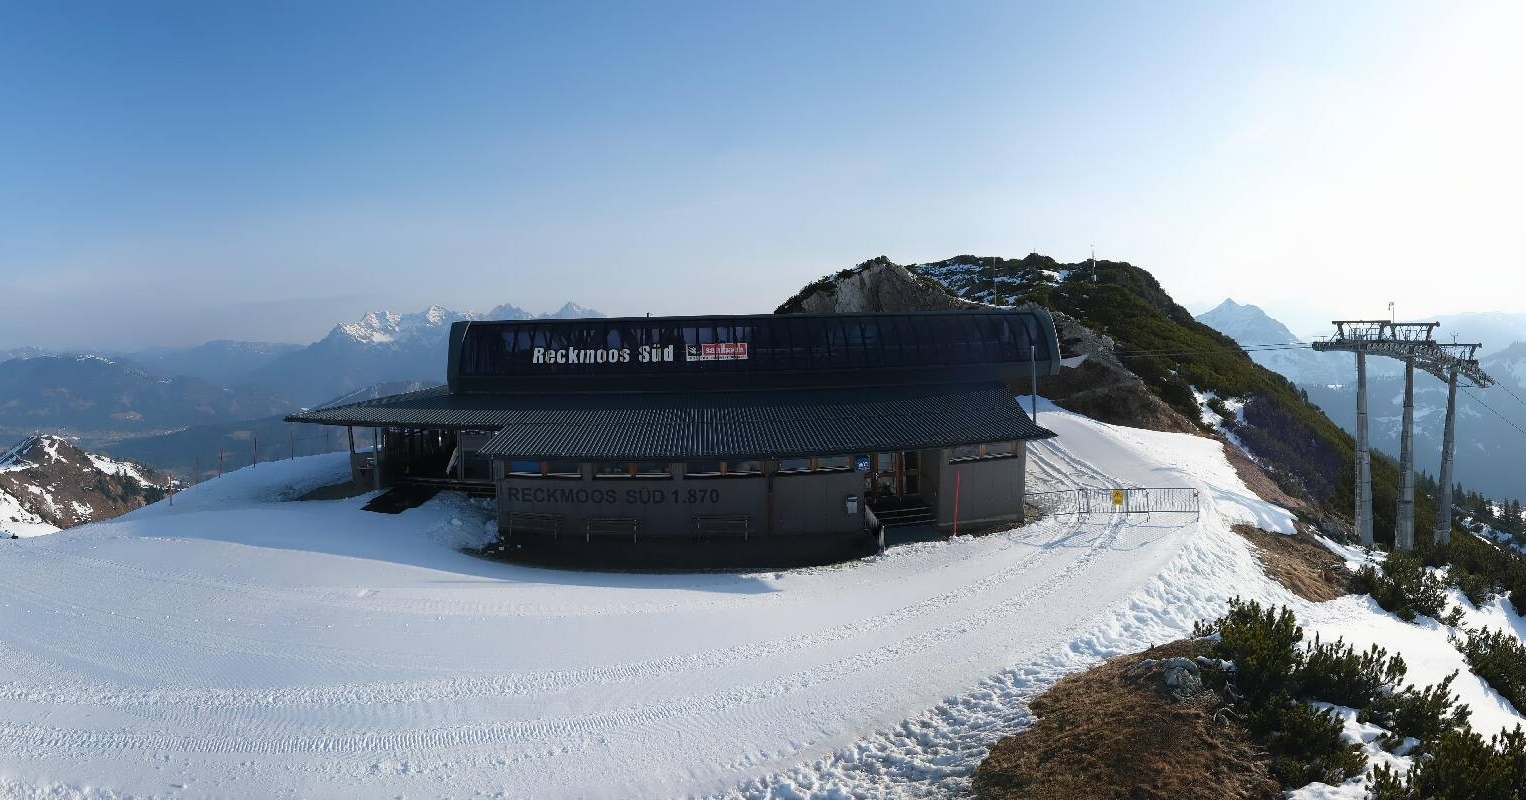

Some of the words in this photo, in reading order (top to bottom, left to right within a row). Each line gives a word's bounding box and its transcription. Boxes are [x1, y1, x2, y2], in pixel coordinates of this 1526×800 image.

[532, 346, 630, 364] Reckmoos
[639, 344, 674, 363] Süd
[507, 487, 617, 504] RECKMOOS
[625, 486, 665, 505] SÜD
[671, 489, 719, 504] 1.870
